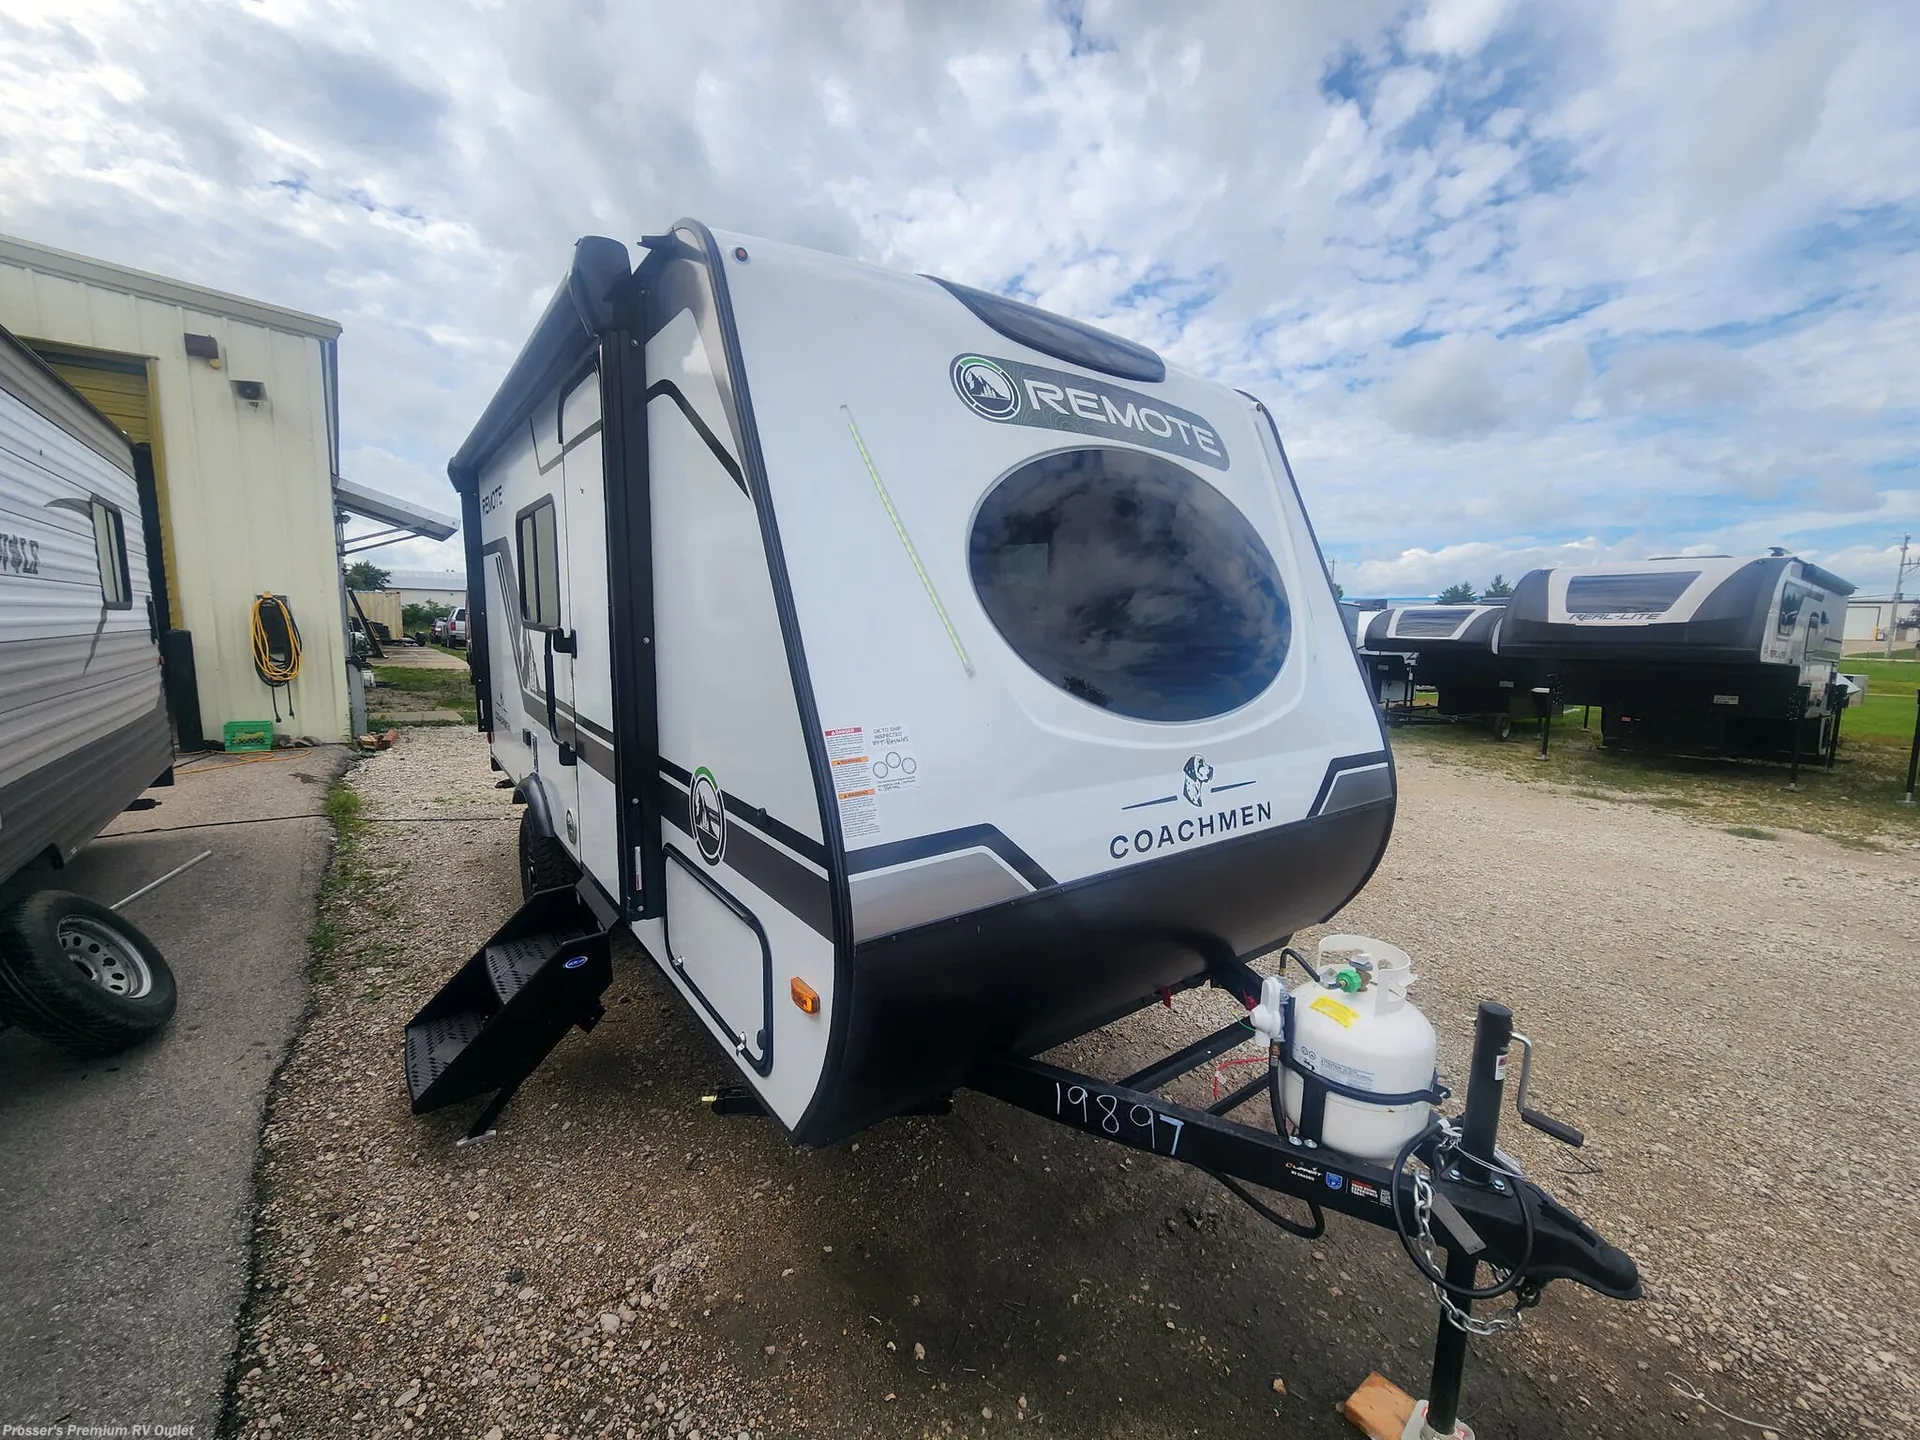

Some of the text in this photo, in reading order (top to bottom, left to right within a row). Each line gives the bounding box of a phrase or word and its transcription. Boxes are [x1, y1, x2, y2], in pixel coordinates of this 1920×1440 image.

[1023, 378, 1222, 458] REMOTE
[482, 485, 502, 516] REMOTE
[1569, 612, 1663, 621] REAL-LITE
[1110, 801, 1273, 859] COACHMEN
[1056, 1082, 1185, 1156] 19897
